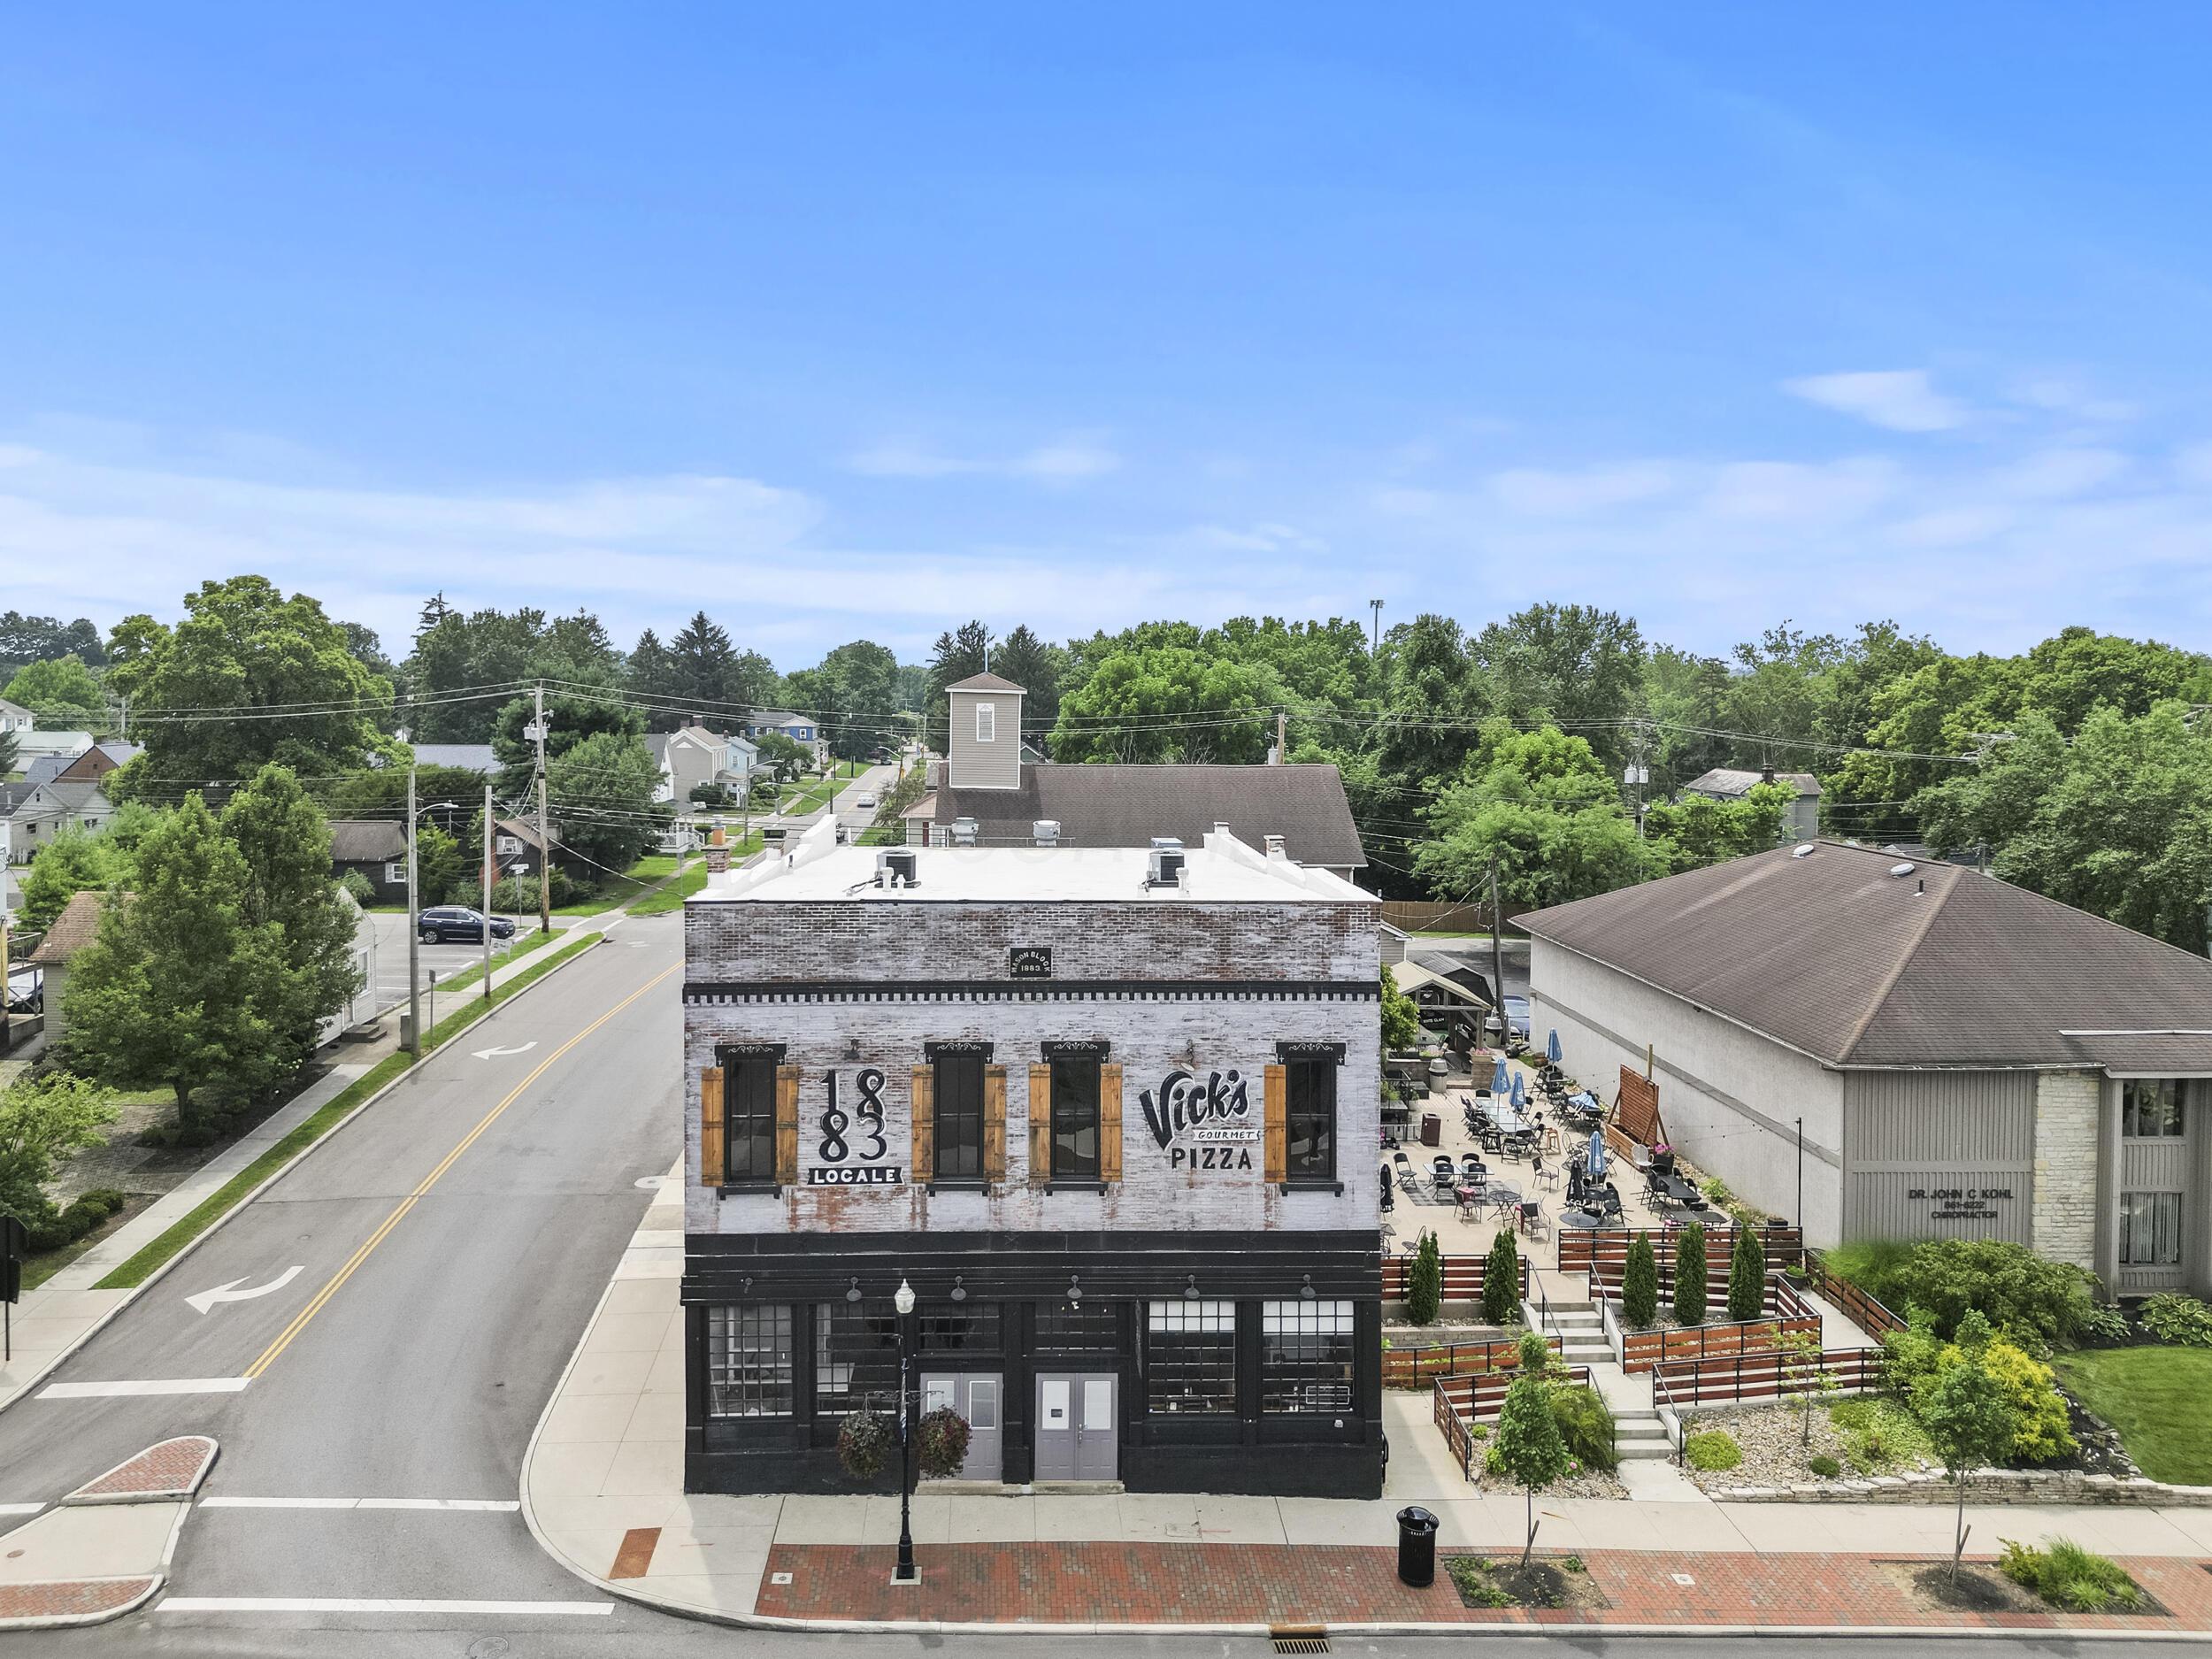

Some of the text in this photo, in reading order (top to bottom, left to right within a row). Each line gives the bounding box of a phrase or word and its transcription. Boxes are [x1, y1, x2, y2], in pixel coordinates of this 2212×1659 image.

[1139, 1069, 1248, 1150] Vick's
[1198, 1131, 1255, 1140] GOURMET
[1171, 1148, 1252, 1169] PIZZA
[814, 1170, 895, 1184] LOCALE
[1909, 1189, 2013, 1199] DR. JOHN C KOHL
